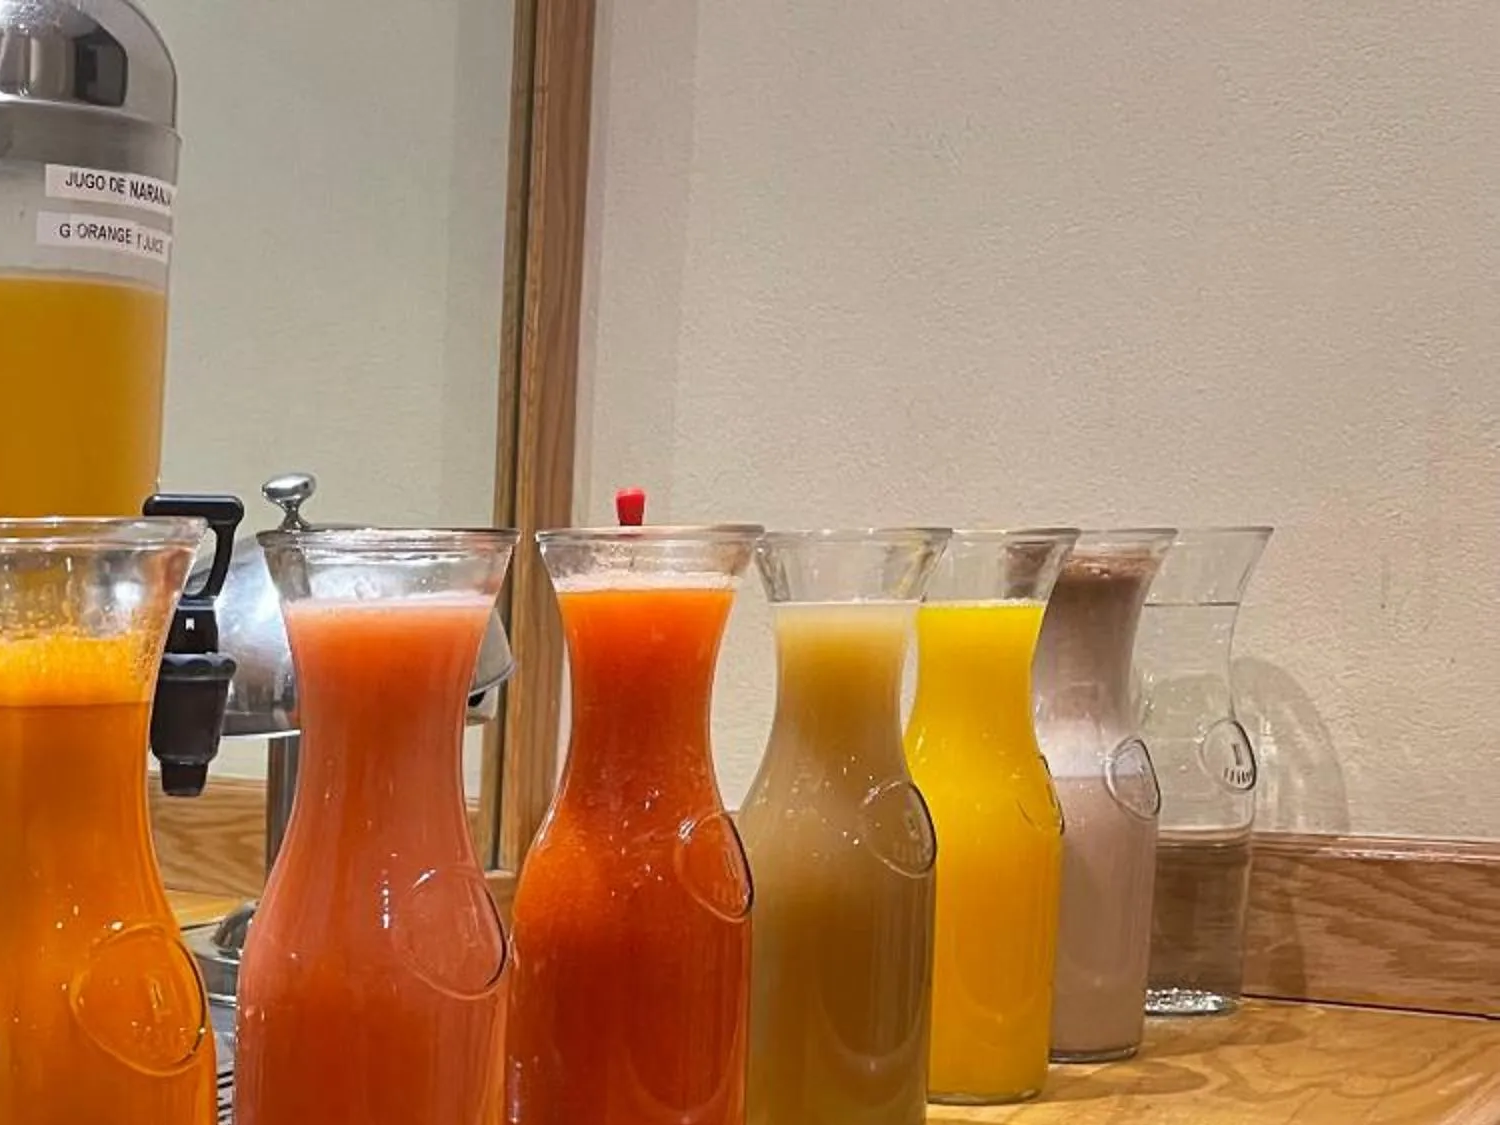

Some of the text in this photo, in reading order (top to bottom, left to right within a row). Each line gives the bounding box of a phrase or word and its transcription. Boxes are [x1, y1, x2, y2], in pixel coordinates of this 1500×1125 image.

[65, 170, 106, 191] JUGO
[109, 177, 125, 194] DE
[77, 223, 132, 244] ORANGE
